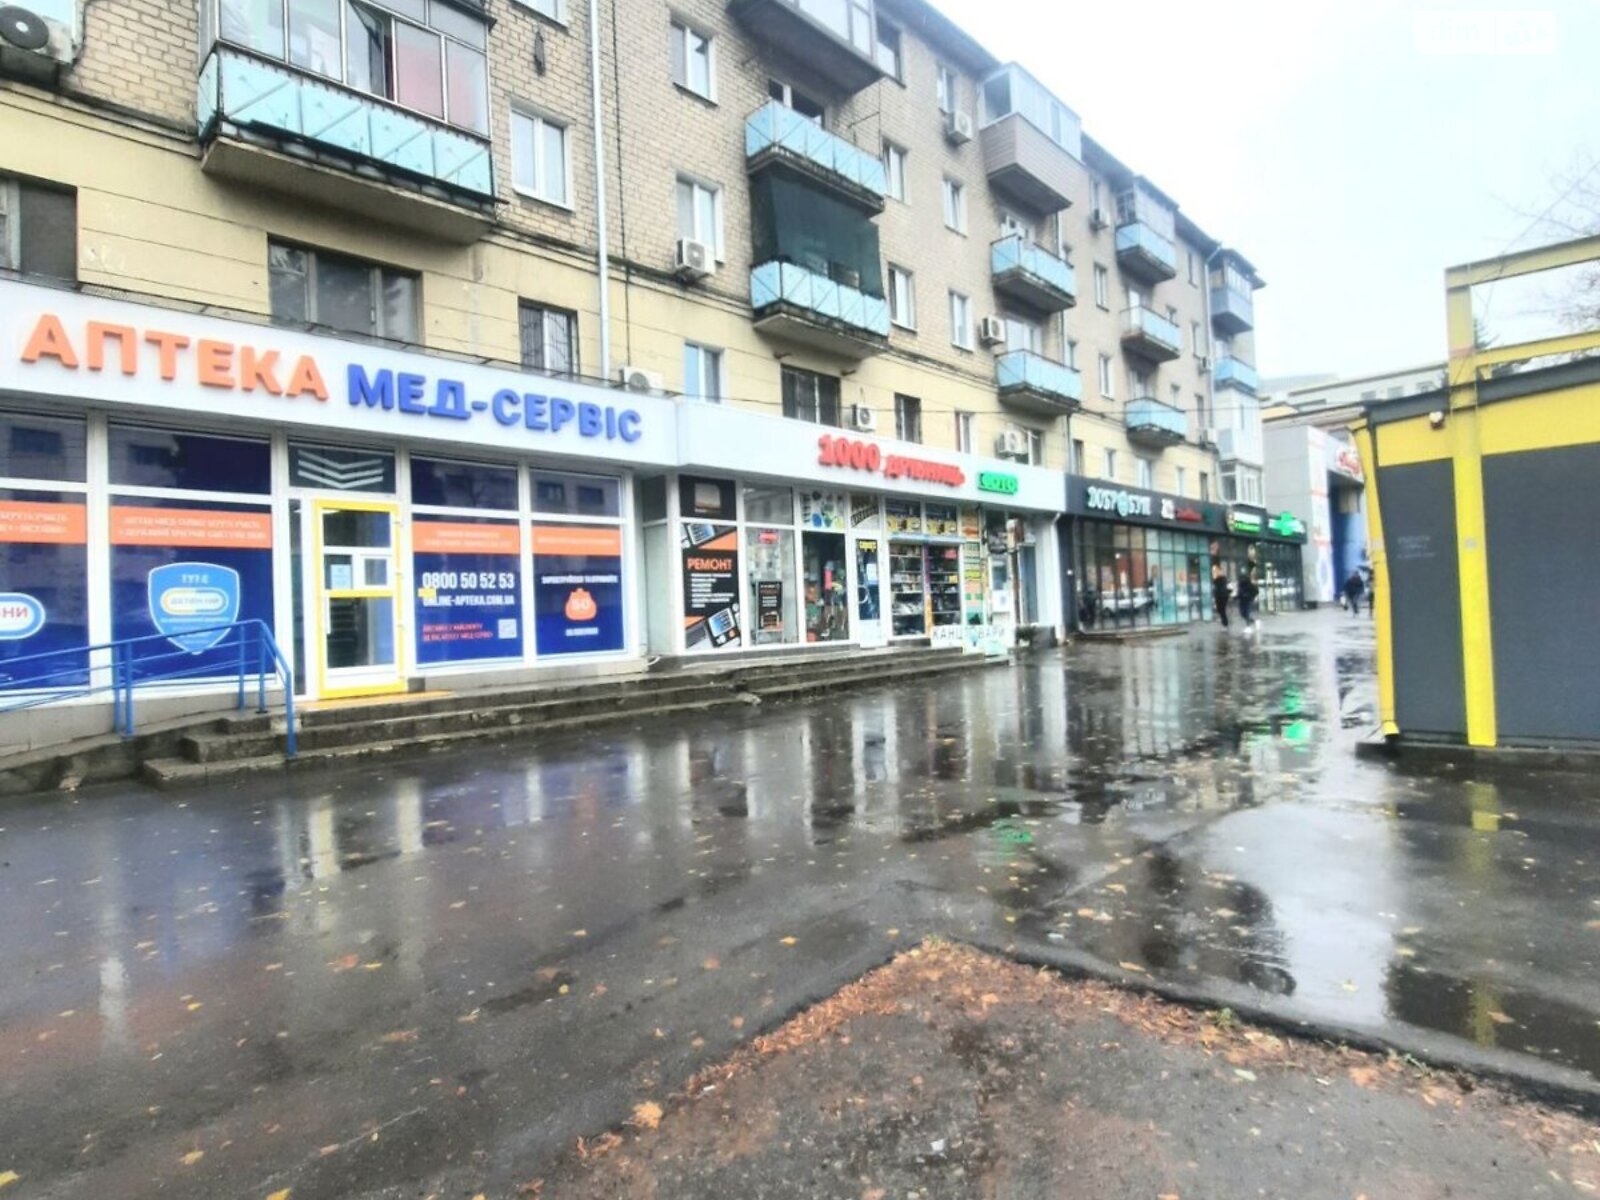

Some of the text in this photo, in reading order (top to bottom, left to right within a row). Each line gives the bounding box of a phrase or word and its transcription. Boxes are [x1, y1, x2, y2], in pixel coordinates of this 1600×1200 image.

[21, 314, 642, 442] АПТЕКА МЕД-СЕРВІС
[818, 434, 881, 473] 1000
[687, 557, 733, 571] РЕМОНТ
[422, 572, 515, 589] 0800 50 52 53
